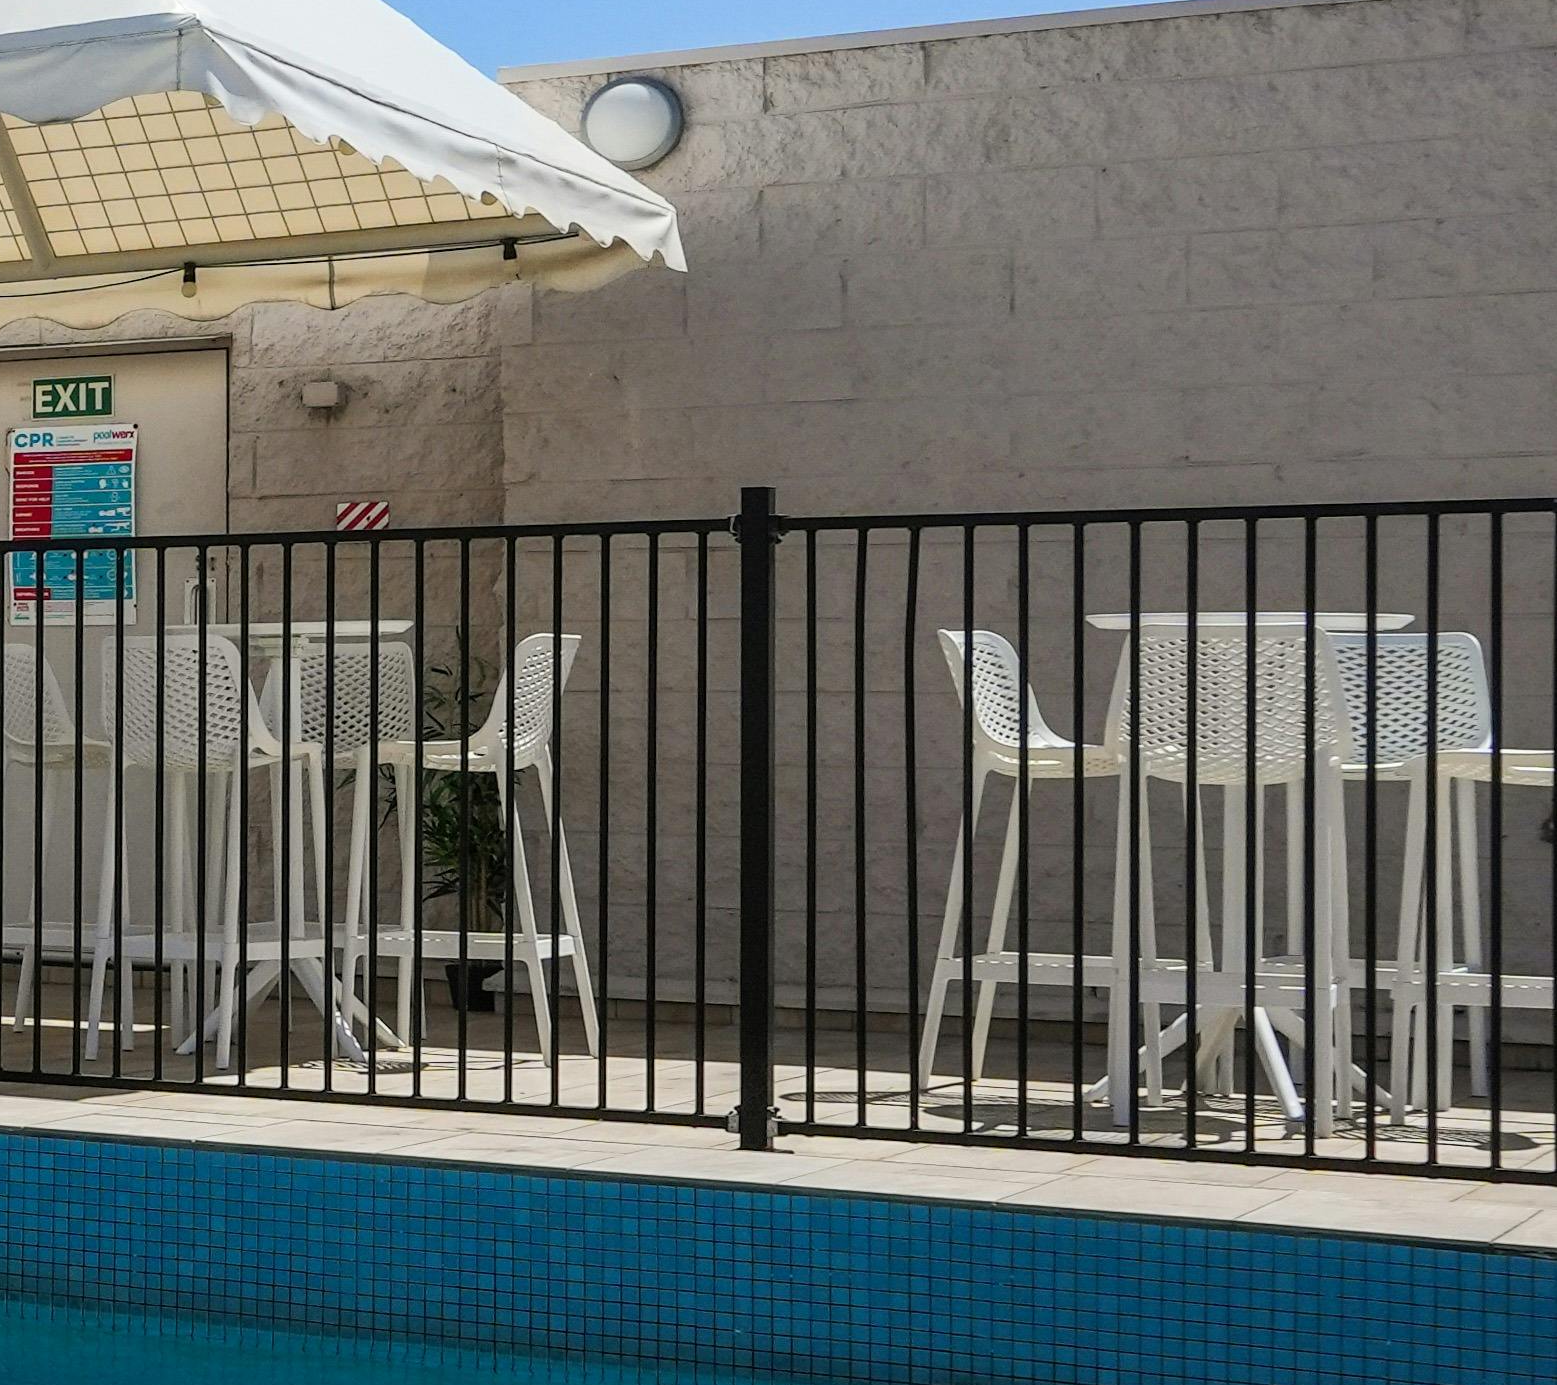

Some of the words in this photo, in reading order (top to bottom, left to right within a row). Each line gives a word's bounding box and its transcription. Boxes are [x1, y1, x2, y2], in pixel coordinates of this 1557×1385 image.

[35, 381, 109, 413] EXIT
[14, 432, 54, 448] CPR
[93, 429, 135, 443] poolwerx
